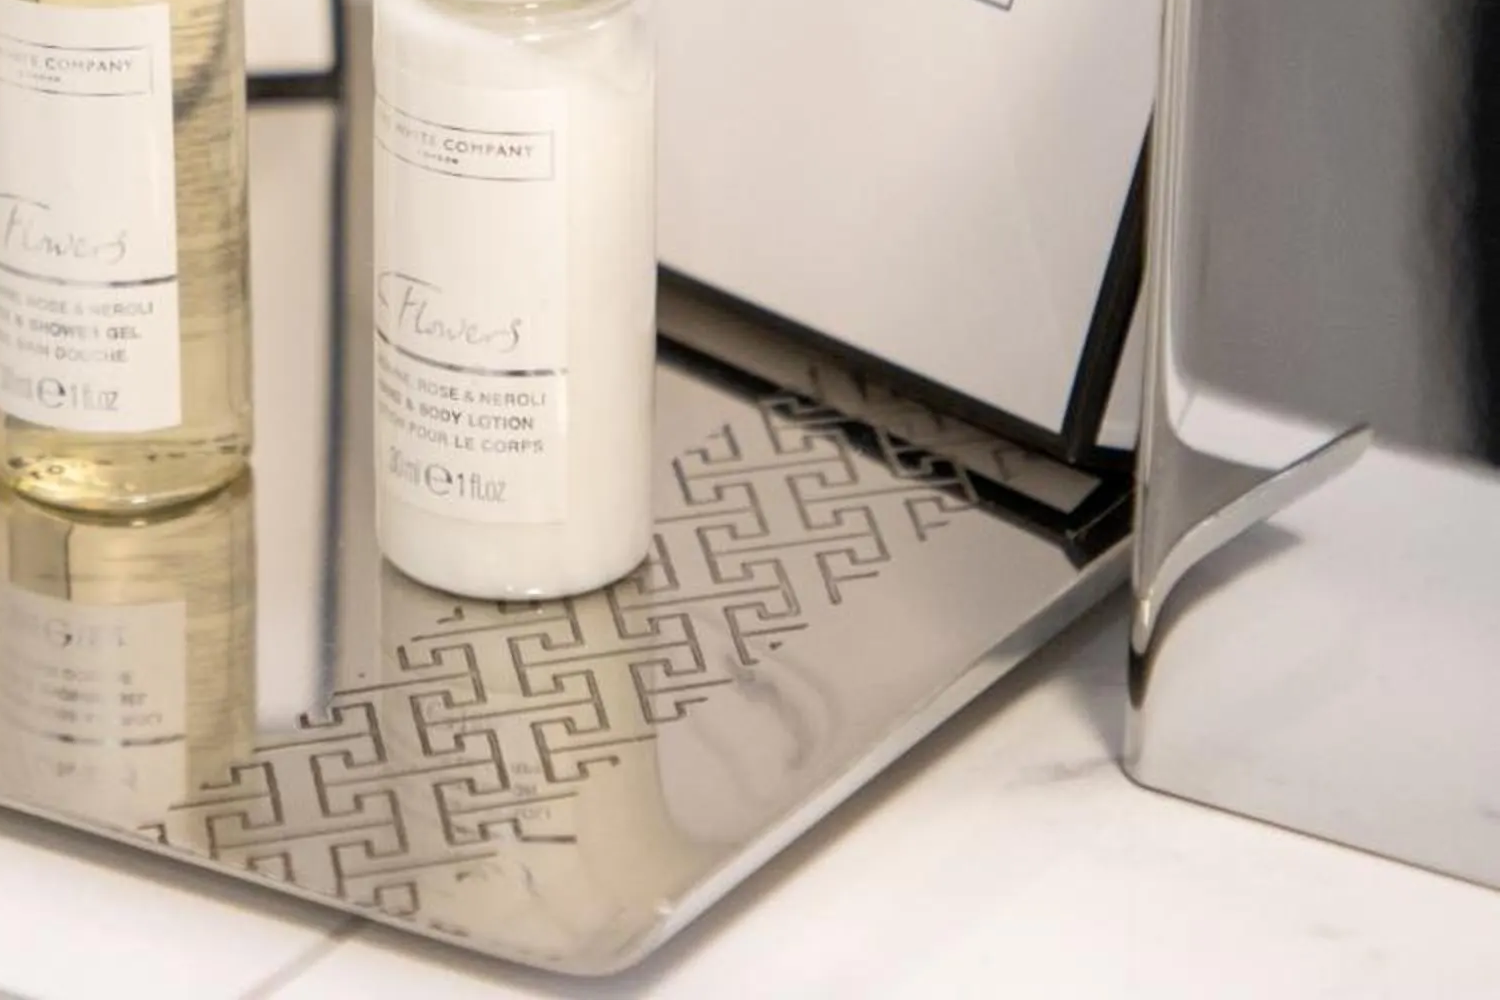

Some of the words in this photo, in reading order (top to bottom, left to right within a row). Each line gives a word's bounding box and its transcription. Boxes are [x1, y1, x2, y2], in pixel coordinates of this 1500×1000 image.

[45, 57, 132, 73] COMPANY
[443, 137, 534, 159] COMPANY
[378, 271, 523, 353] Flowers
[417, 377, 461, 401] ROSE
[479, 391, 547, 407] NEROLI
[418, 402, 462, 426] BODY
[468, 413, 535, 431] LOTION
[408, 420, 450, 446] POUR
[454, 433, 475, 450] LE
[481, 439, 545, 454] CORPS
